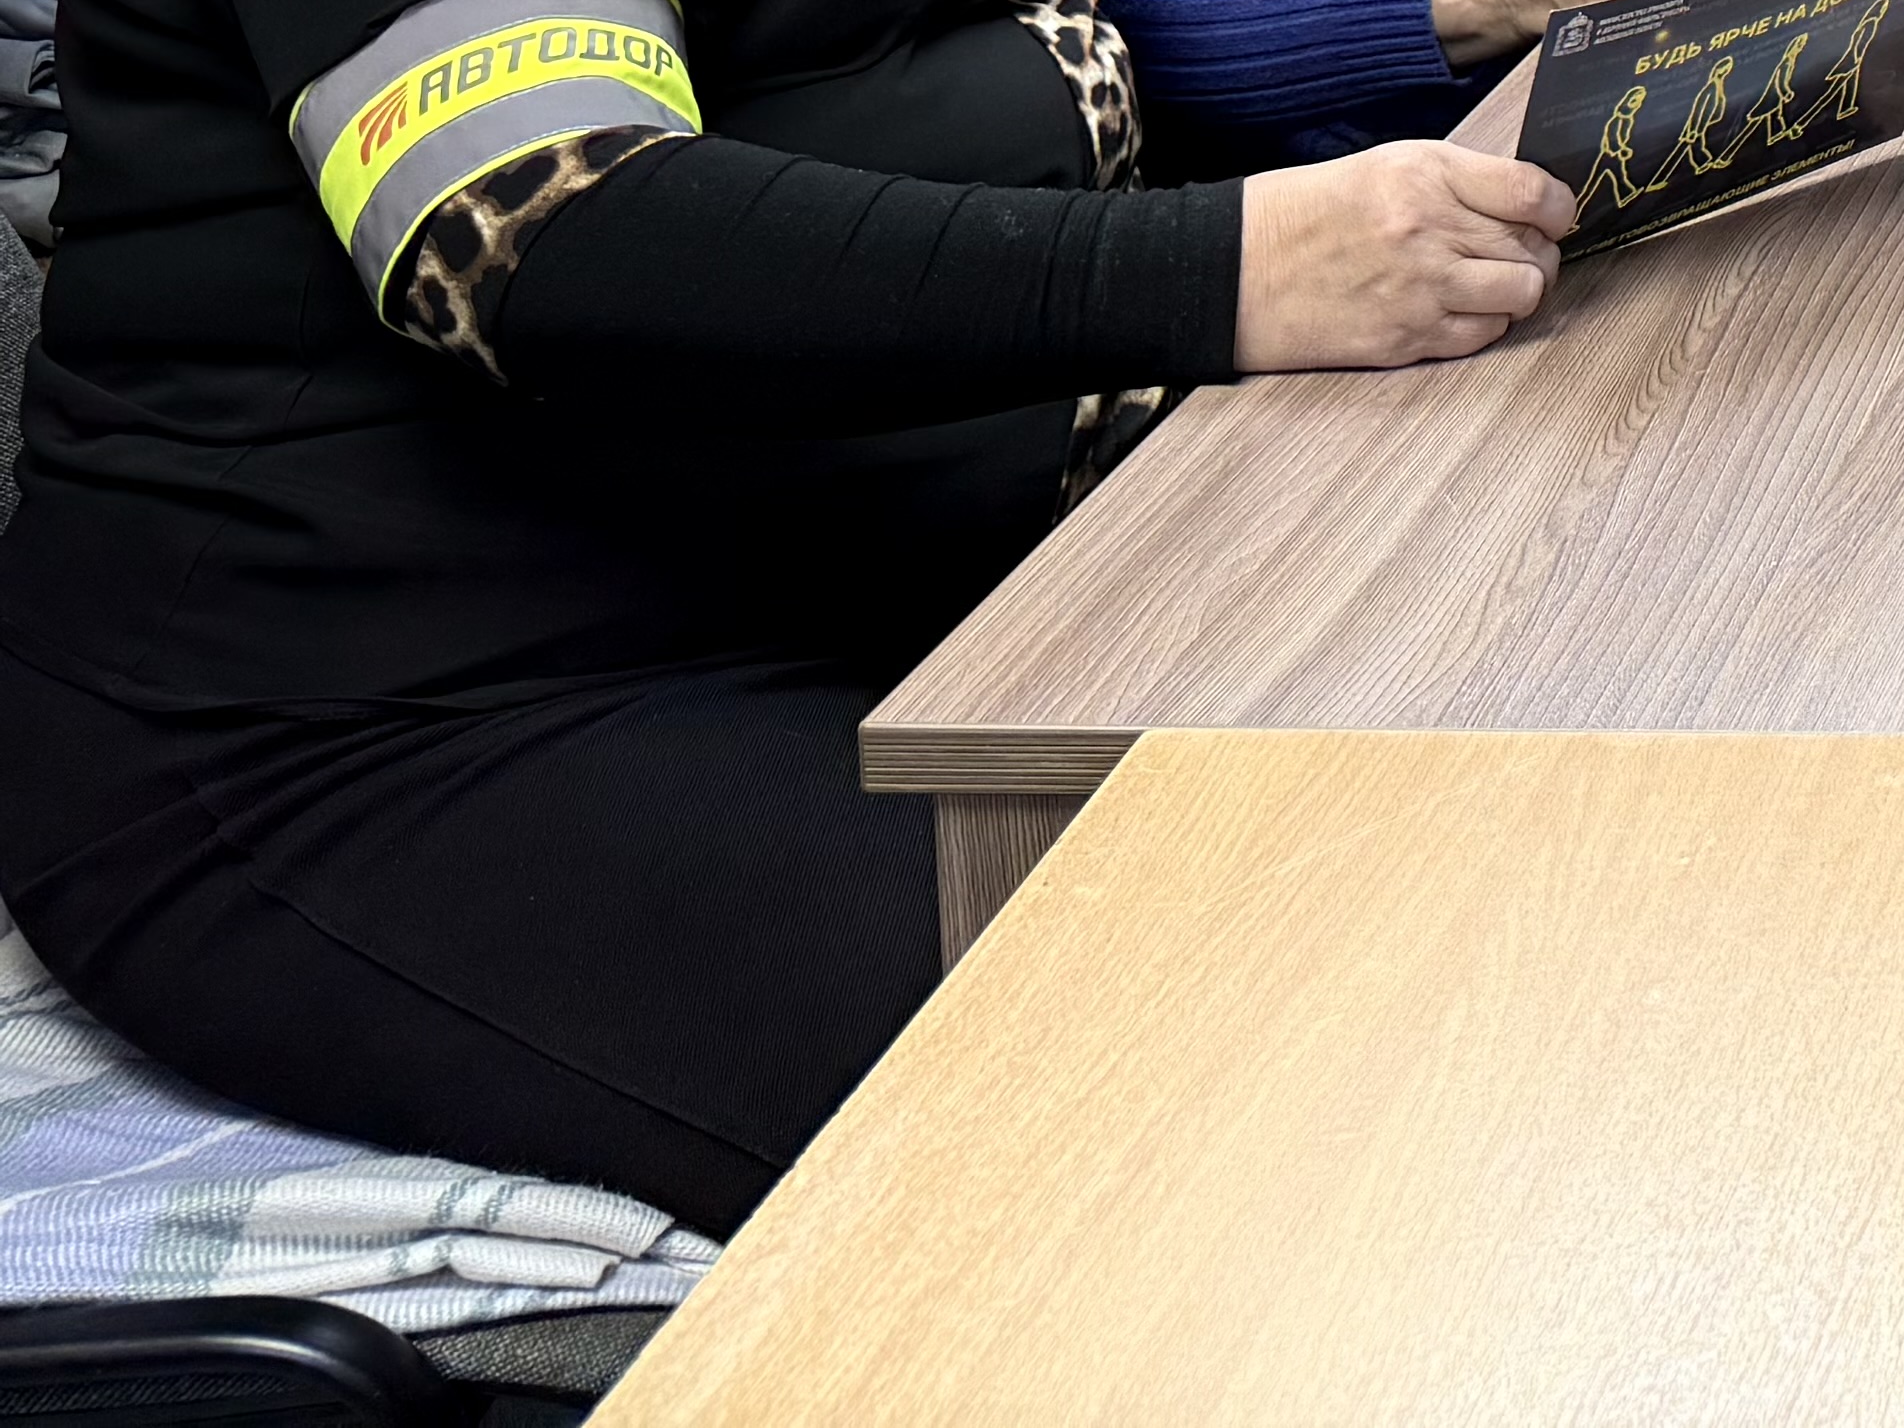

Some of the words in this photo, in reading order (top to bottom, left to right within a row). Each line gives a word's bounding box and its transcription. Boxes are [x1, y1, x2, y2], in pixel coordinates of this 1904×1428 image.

[419, 26, 674, 116] АВТОДОР
[1635, 42, 1702, 75] БУДЬ
[1709, 16, 1772, 51] ЯРЧЕ
[1774, 4, 1807, 28] НА
